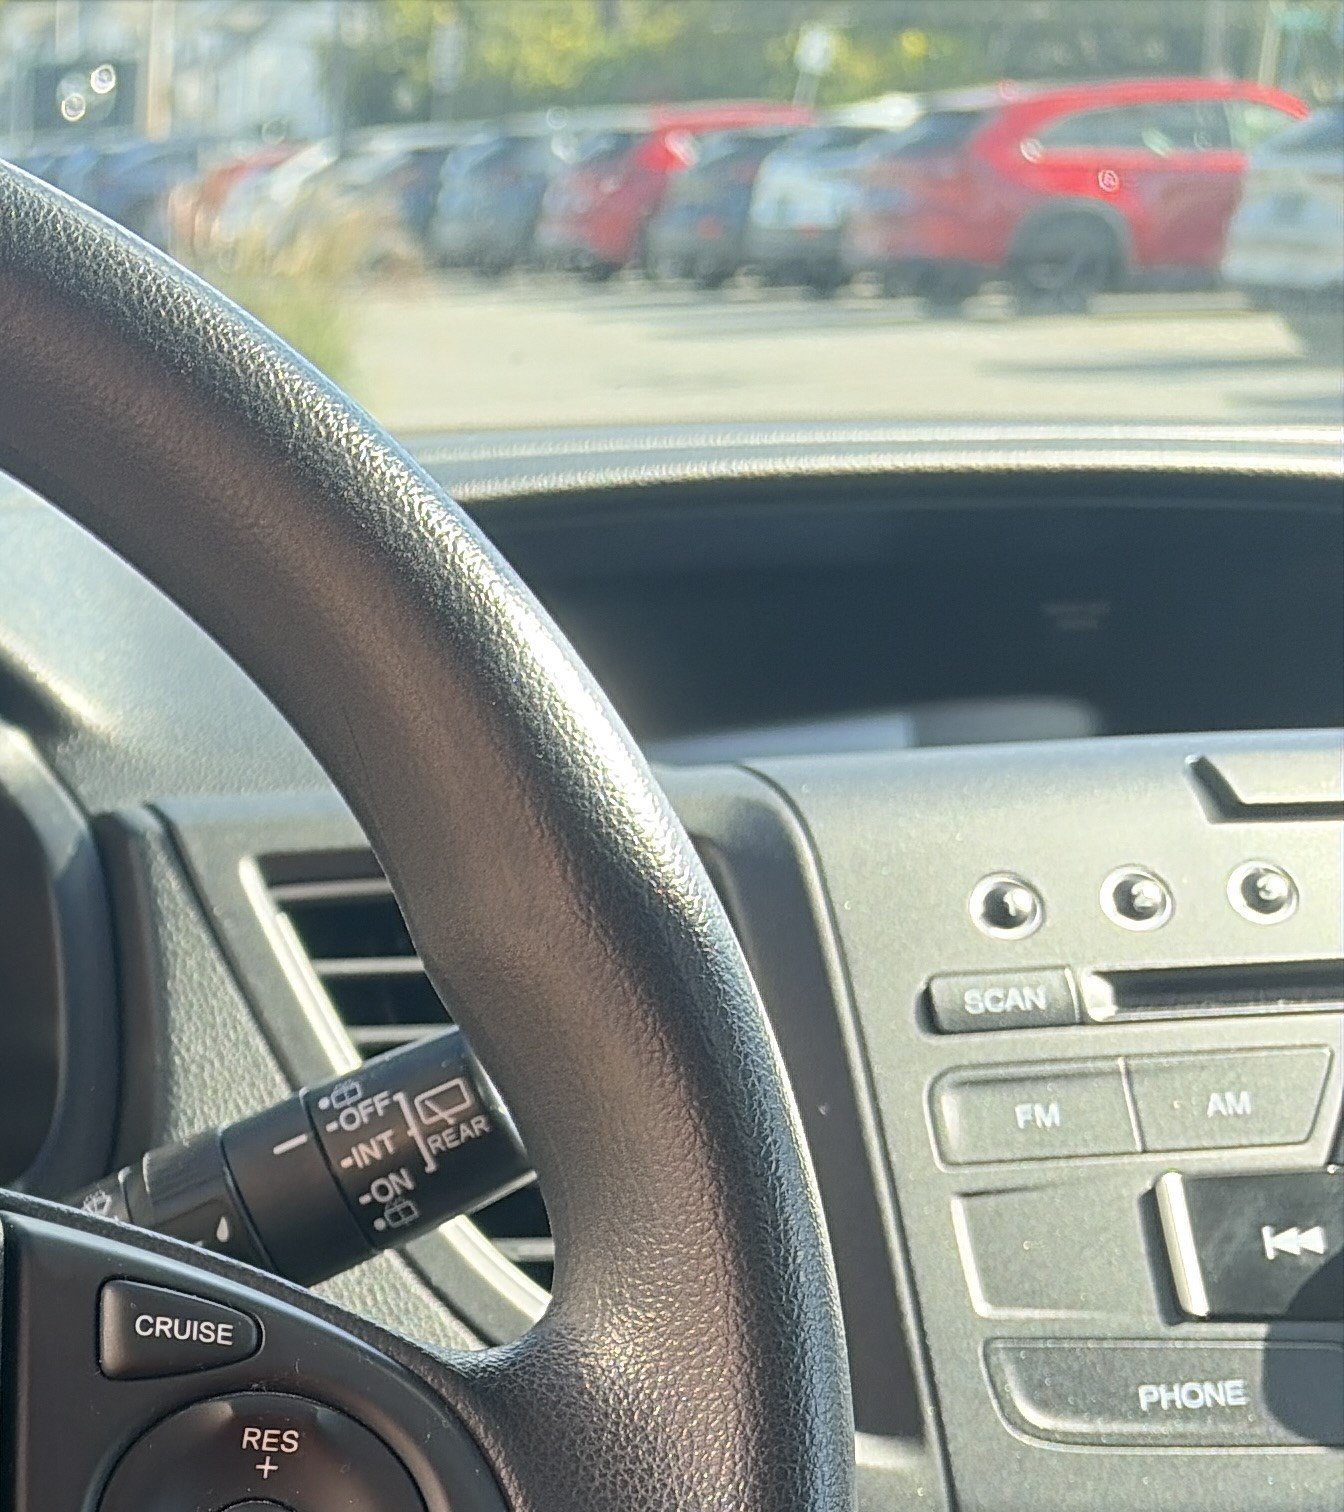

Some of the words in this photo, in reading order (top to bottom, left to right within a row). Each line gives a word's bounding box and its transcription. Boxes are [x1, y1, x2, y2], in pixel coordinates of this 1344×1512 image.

[963, 984, 1048, 1016] SCAN
[338, 1090, 391, 1132] OFF
[1014, 1102, 1062, 1129] FM
[1206, 1091, 1253, 1119] AM
[350, 1128, 396, 1169] INT
[426, 1114, 491, 1156] REAR
[370, 1166, 415, 1205] ON
[134, 1314, 234, 1346] CRUISE
[1138, 1379, 1250, 1414] PHONE
[241, 1426, 300, 1455] RES
